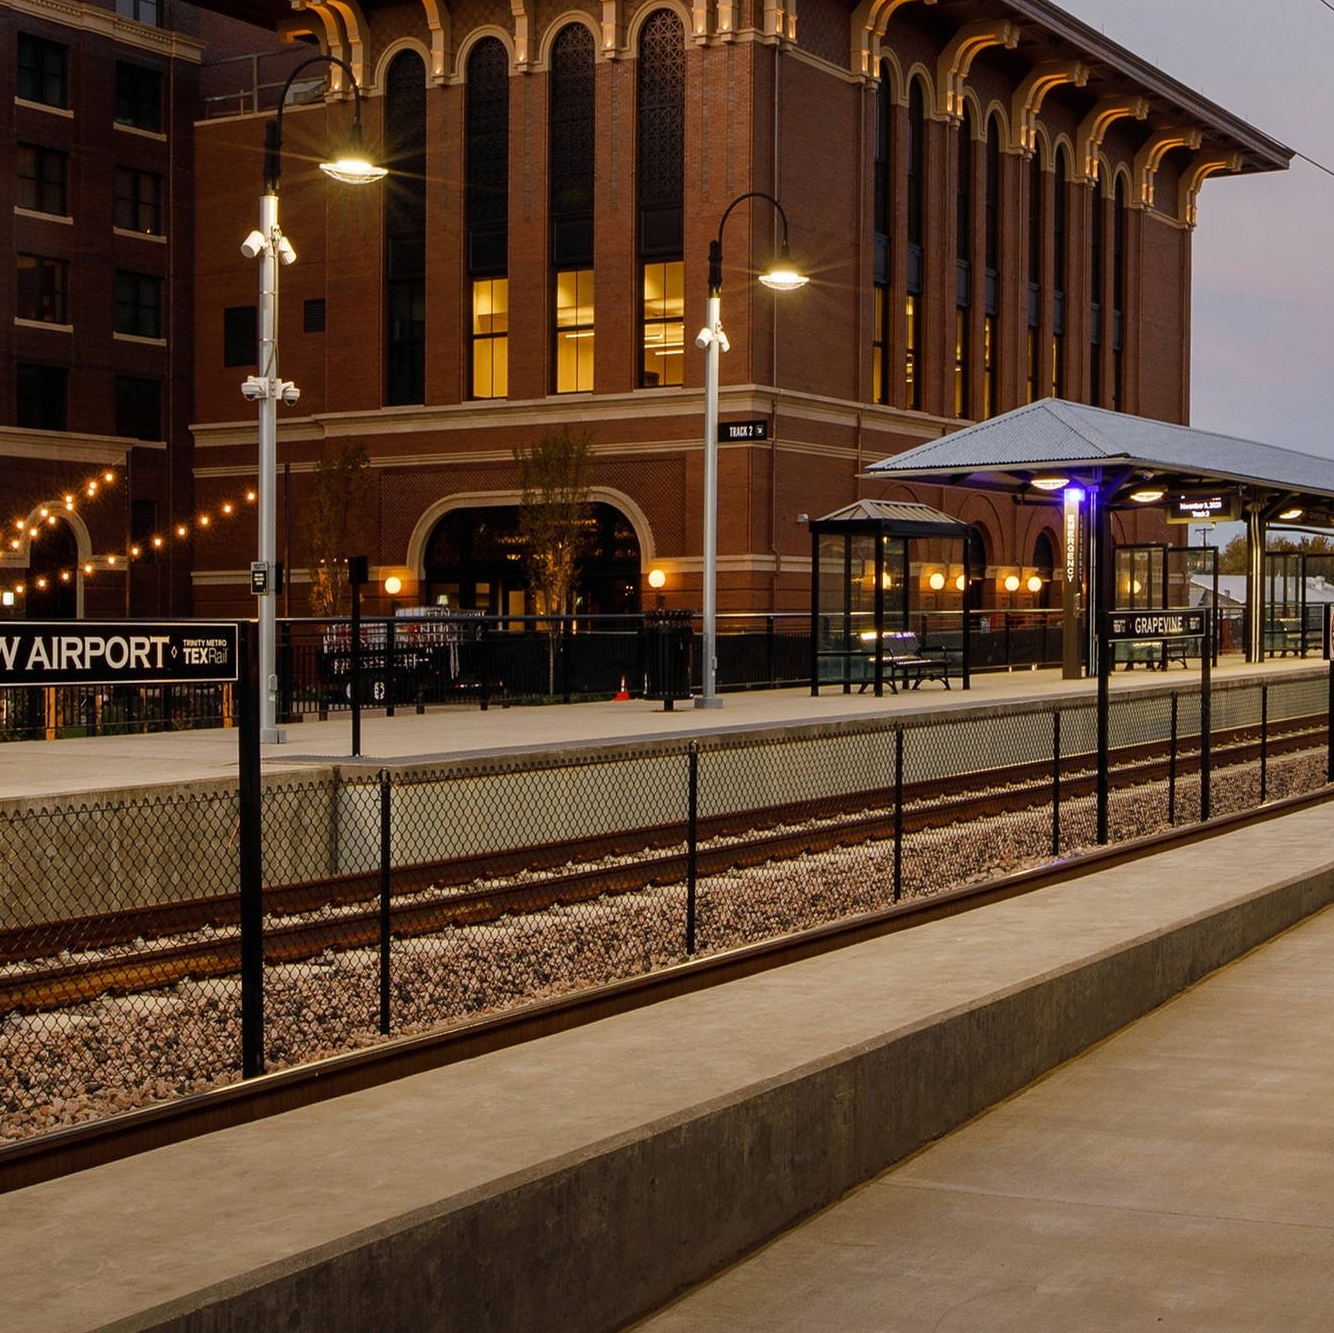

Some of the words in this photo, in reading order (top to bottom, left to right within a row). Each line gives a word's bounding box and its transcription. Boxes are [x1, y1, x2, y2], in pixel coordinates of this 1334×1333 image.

[729, 426, 747, 437] TRACK
[748, 425, 753, 436] 2
[1067, 514, 1075, 583] EMERGENCY
[1135, 616, 1183, 634] GRAPEVINE
[183, 639, 205, 647] TRINITY
[206, 639, 227, 647] METRO
[24, 636, 170, 671] AIRPORT
